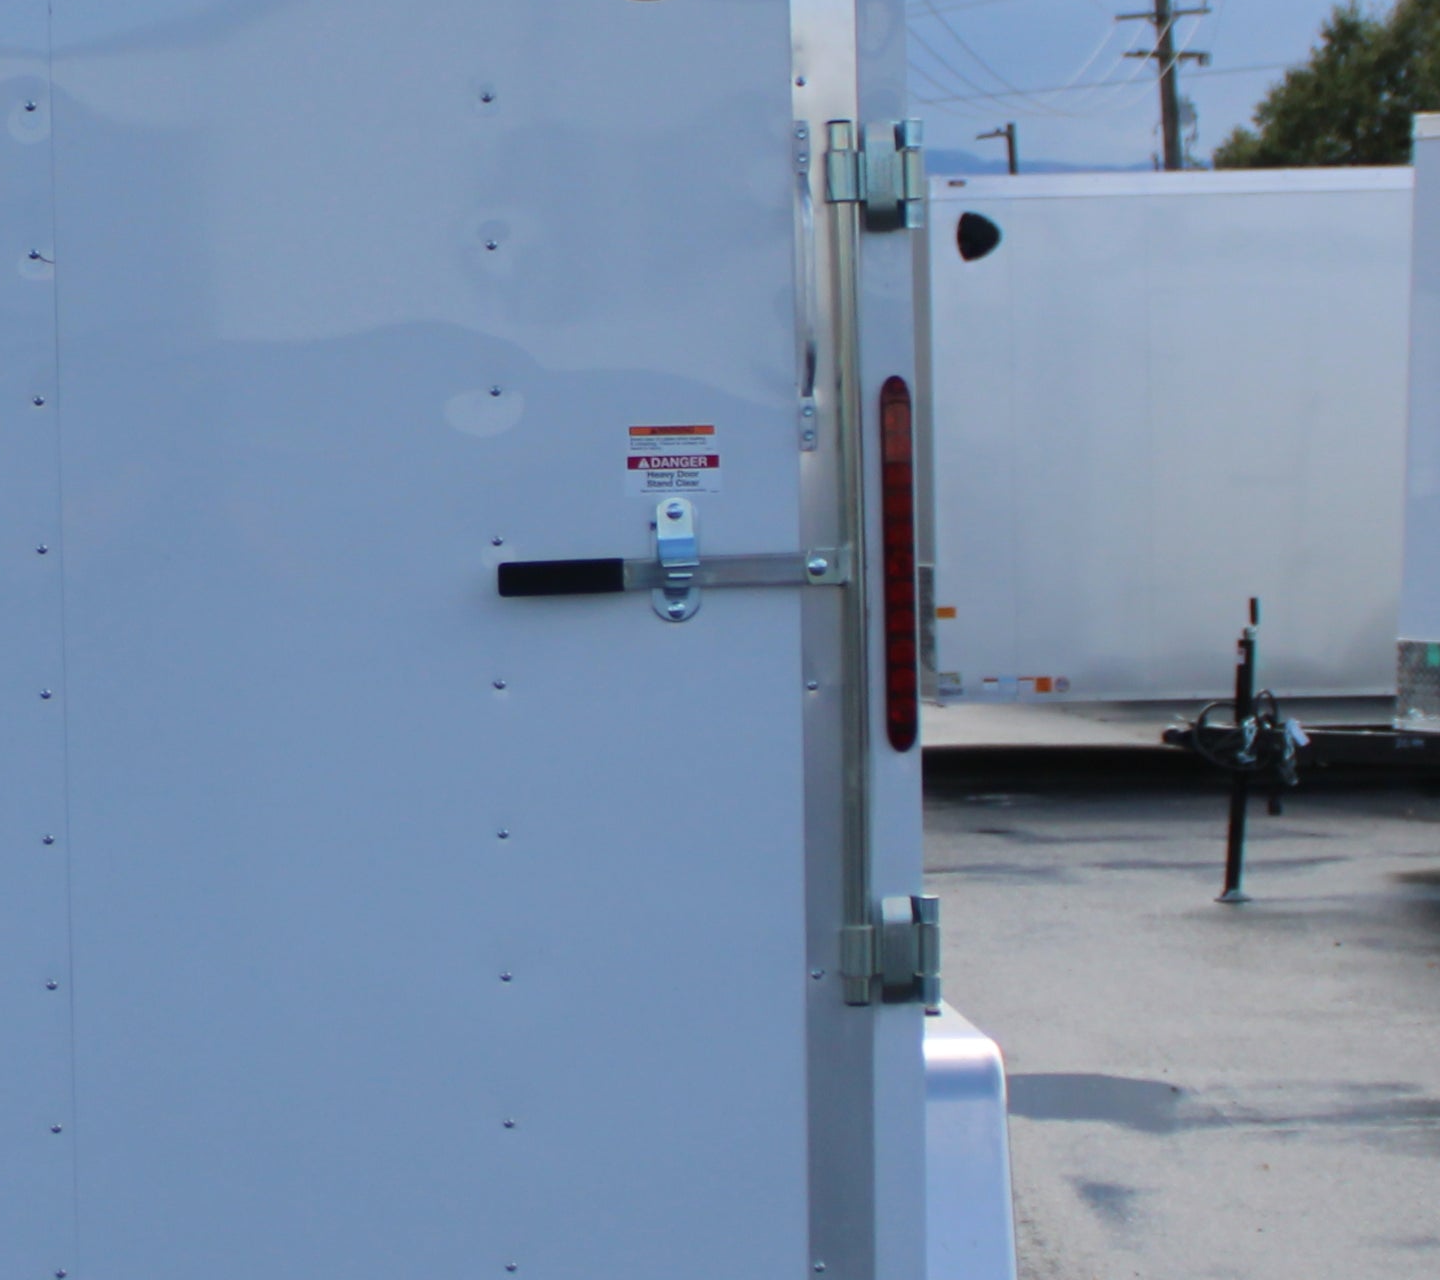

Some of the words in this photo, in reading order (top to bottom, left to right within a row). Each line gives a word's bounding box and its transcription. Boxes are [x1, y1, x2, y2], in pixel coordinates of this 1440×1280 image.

[650, 456, 708, 468] DANGER
[646, 471, 674, 480] Heavy
[677, 470, 699, 478] Door
[646, 479, 673, 488] Stand
[675, 479, 699, 487] Clear
